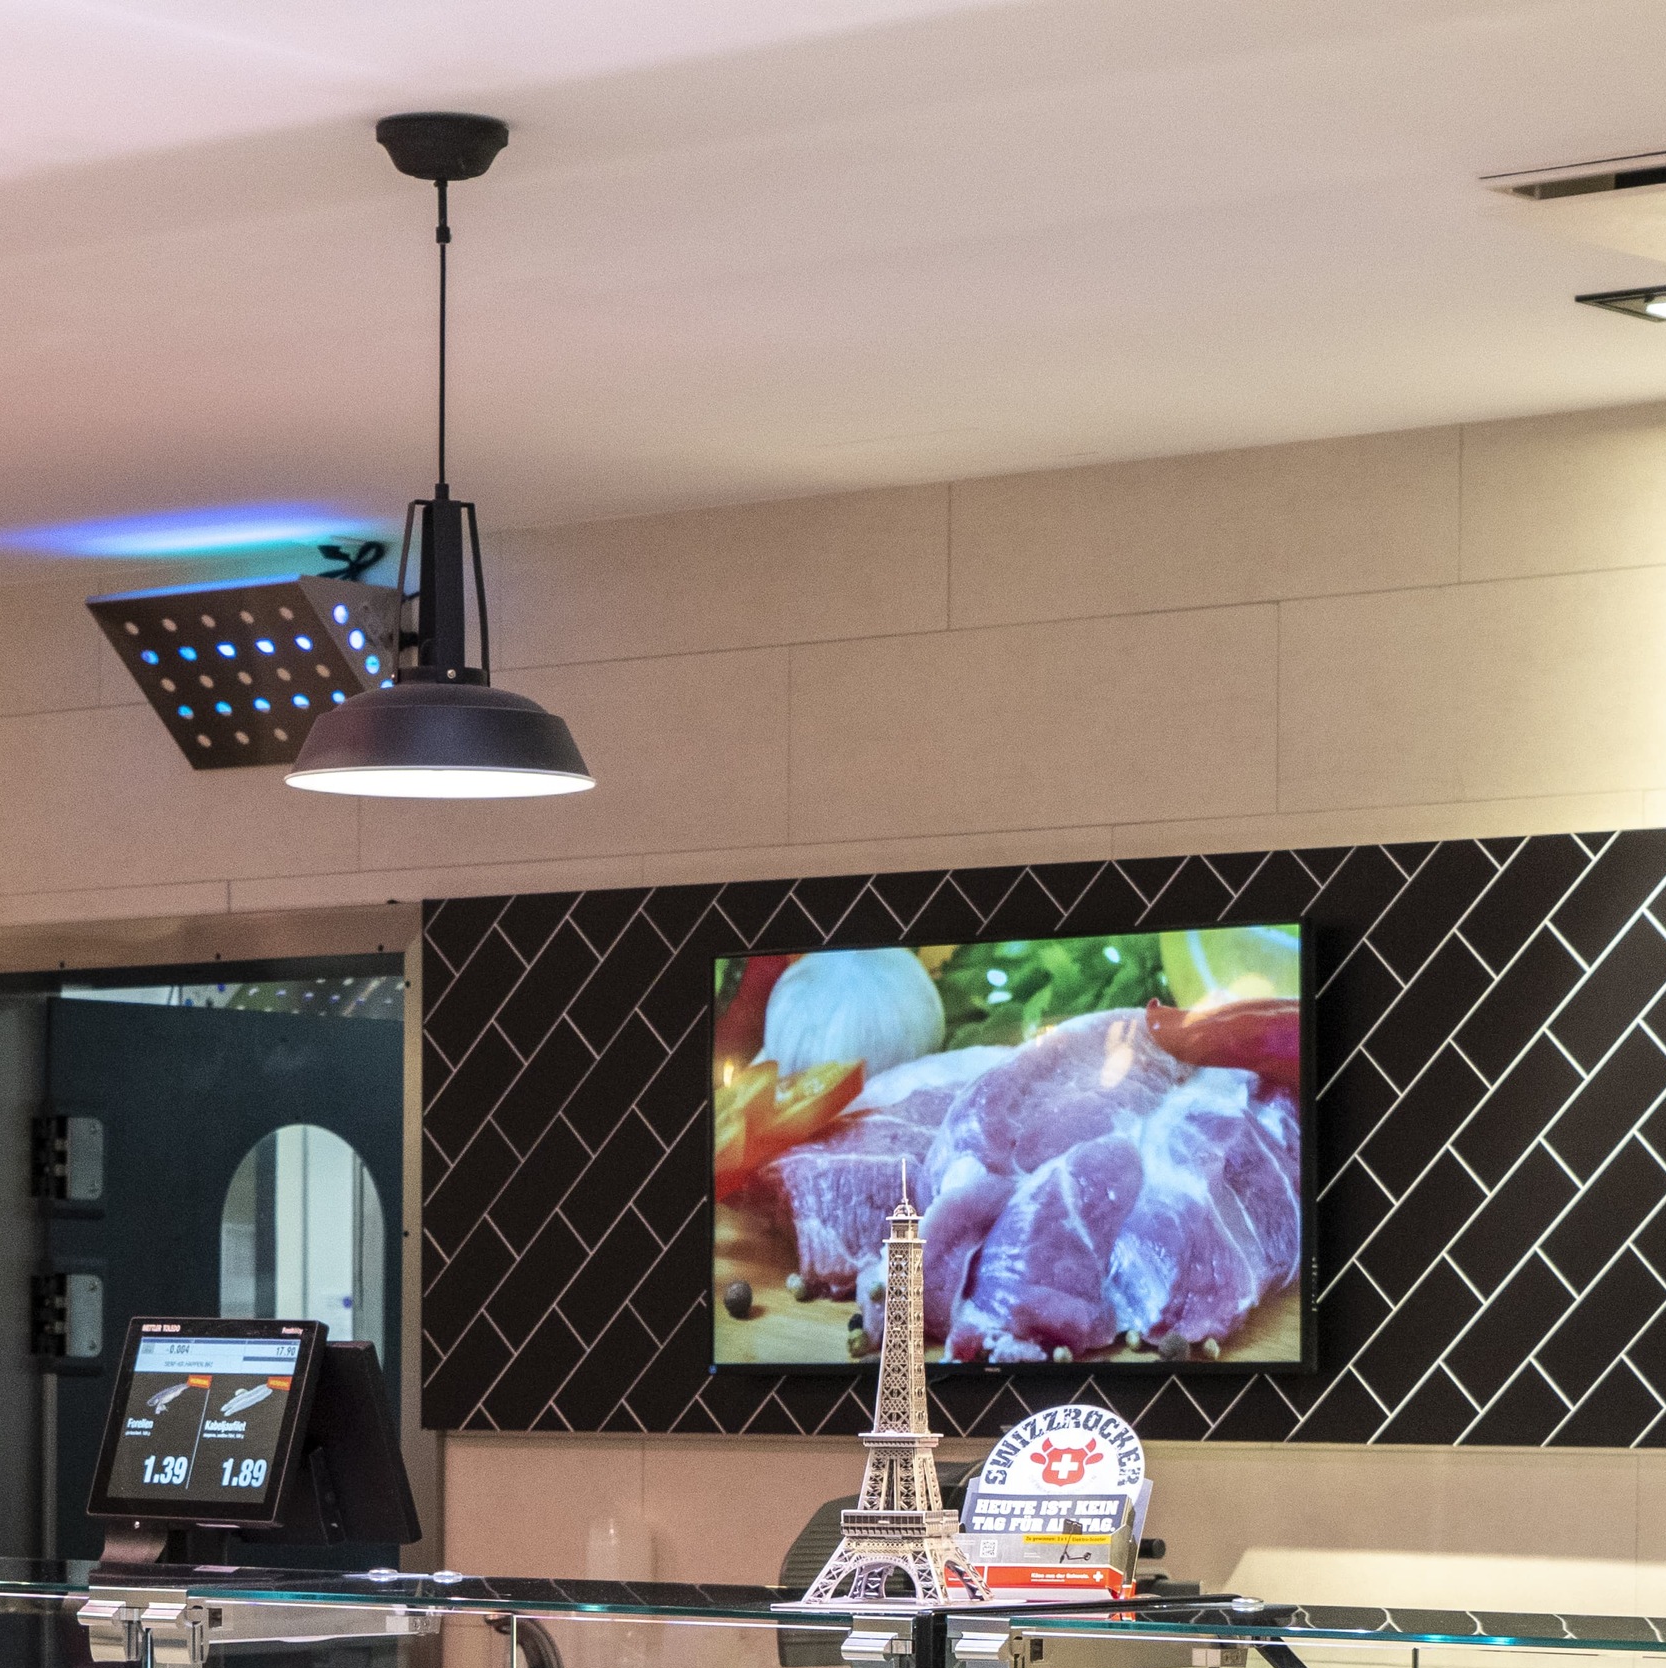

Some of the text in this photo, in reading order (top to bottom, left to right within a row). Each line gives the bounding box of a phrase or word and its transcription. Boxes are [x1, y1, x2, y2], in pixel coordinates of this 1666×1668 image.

[162, 1324, 181, 1332] TOLEDO
[127, 1417, 154, 1429] Forellen
[984, 1408, 1141, 1487] SWIZZROCKER
[143, 1455, 188, 1484] 1.39
[221, 1457, 268, 1488] 1.89
[975, 1499, 1119, 1516] HEUTE IST KEIN
[972, 1516, 1006, 1531] TAG
[1009, 1514, 1044, 1532] FÜR
